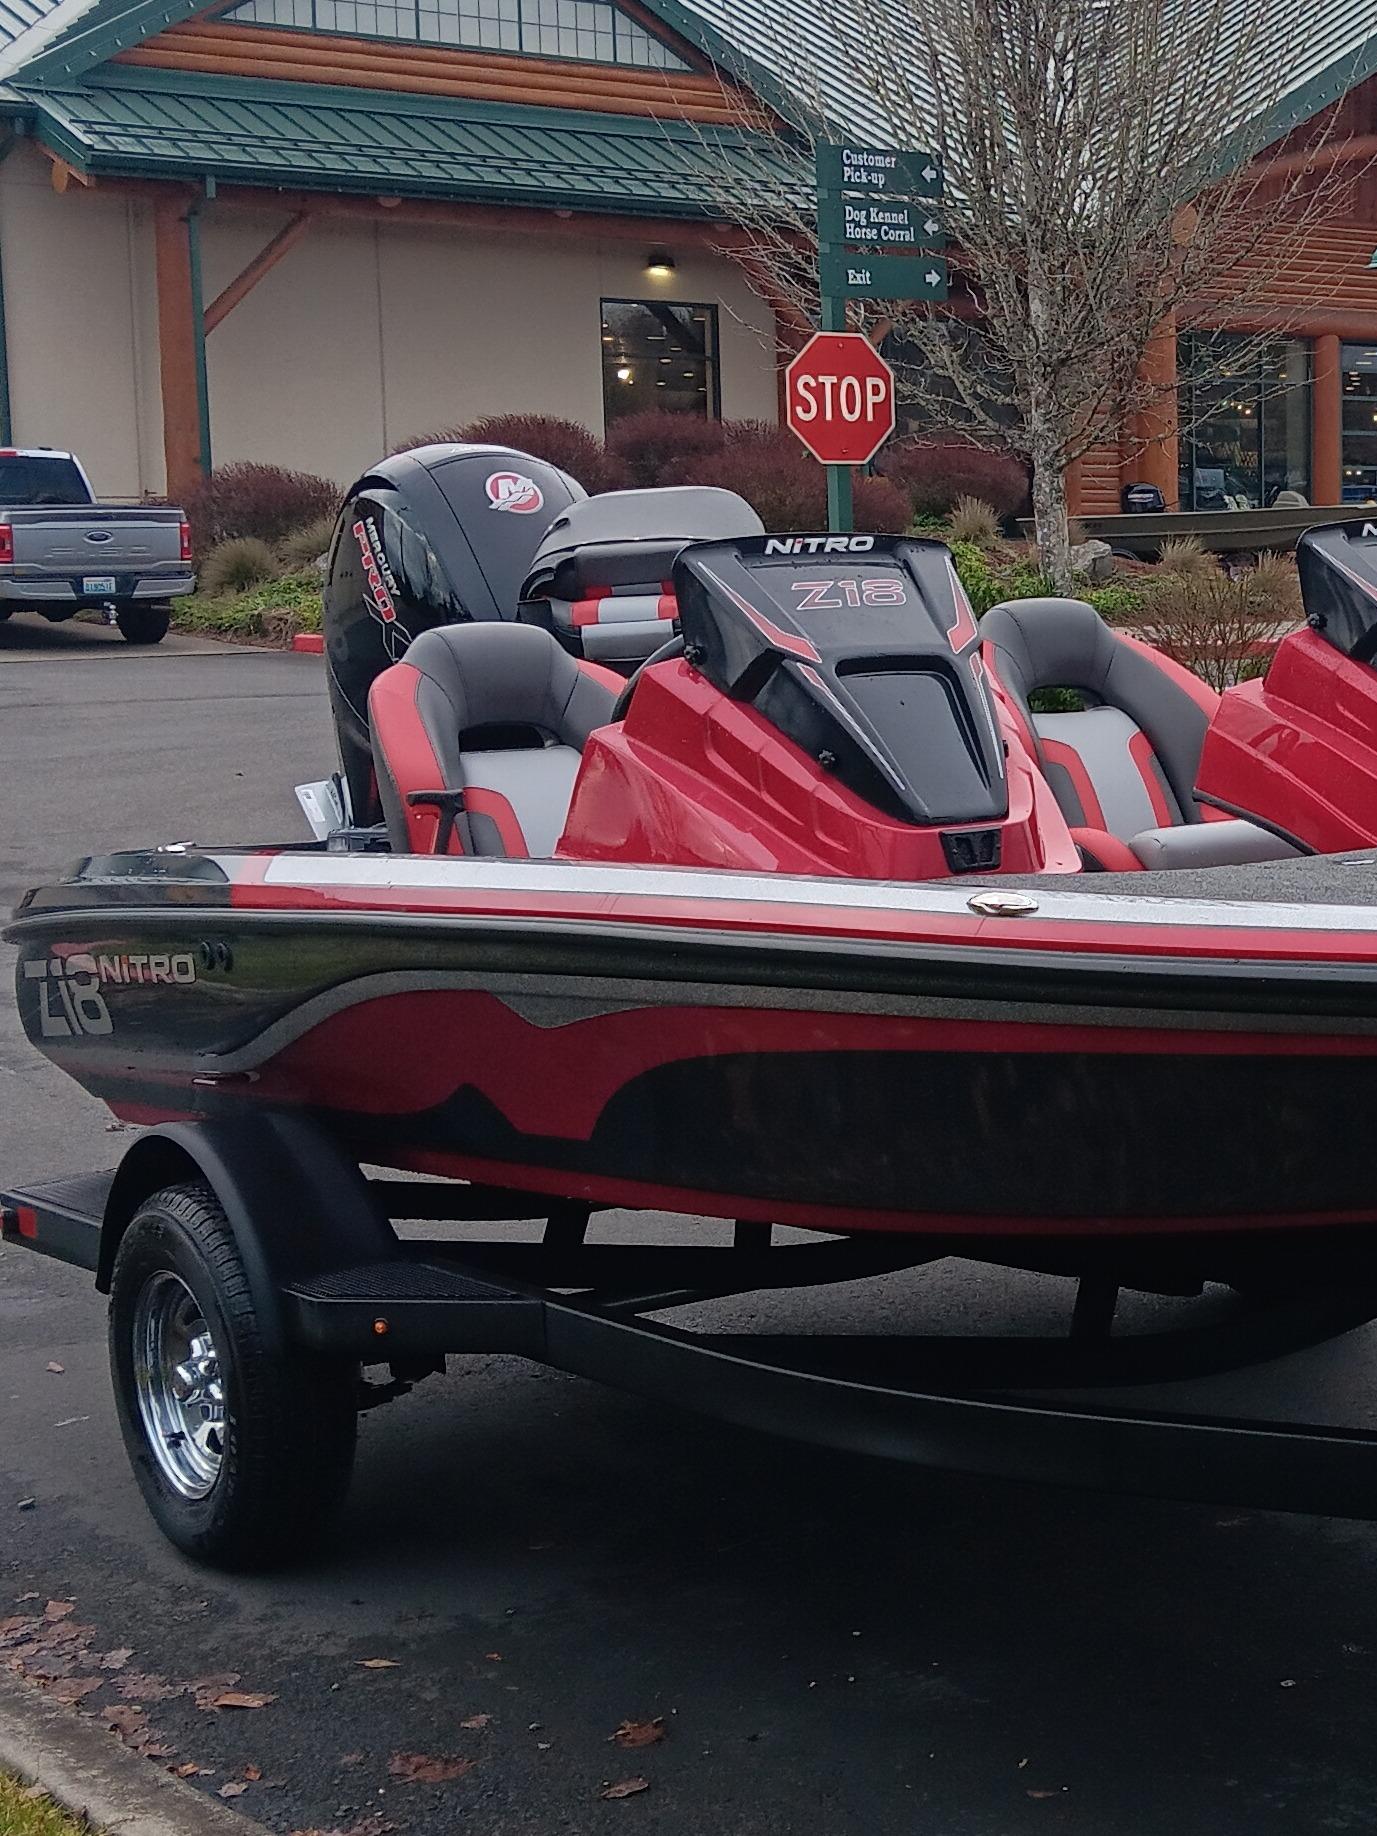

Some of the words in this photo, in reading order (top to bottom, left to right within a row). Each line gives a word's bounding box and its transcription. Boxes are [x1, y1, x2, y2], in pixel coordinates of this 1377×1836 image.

[842, 149, 897, 168] Customer
[843, 166, 885, 188] Pick-up
[845, 206, 867, 226] Dog
[870, 207, 909, 225] Kennel
[845, 223, 878, 240] Horse
[881, 225, 915, 242] Corral
[847, 269, 872, 285] Exit
[795, 374, 887, 422] STOP
[364, 516, 401, 597] MERCURY
[352, 520, 397, 624] PRO
[791, 579, 907, 611] Z18
